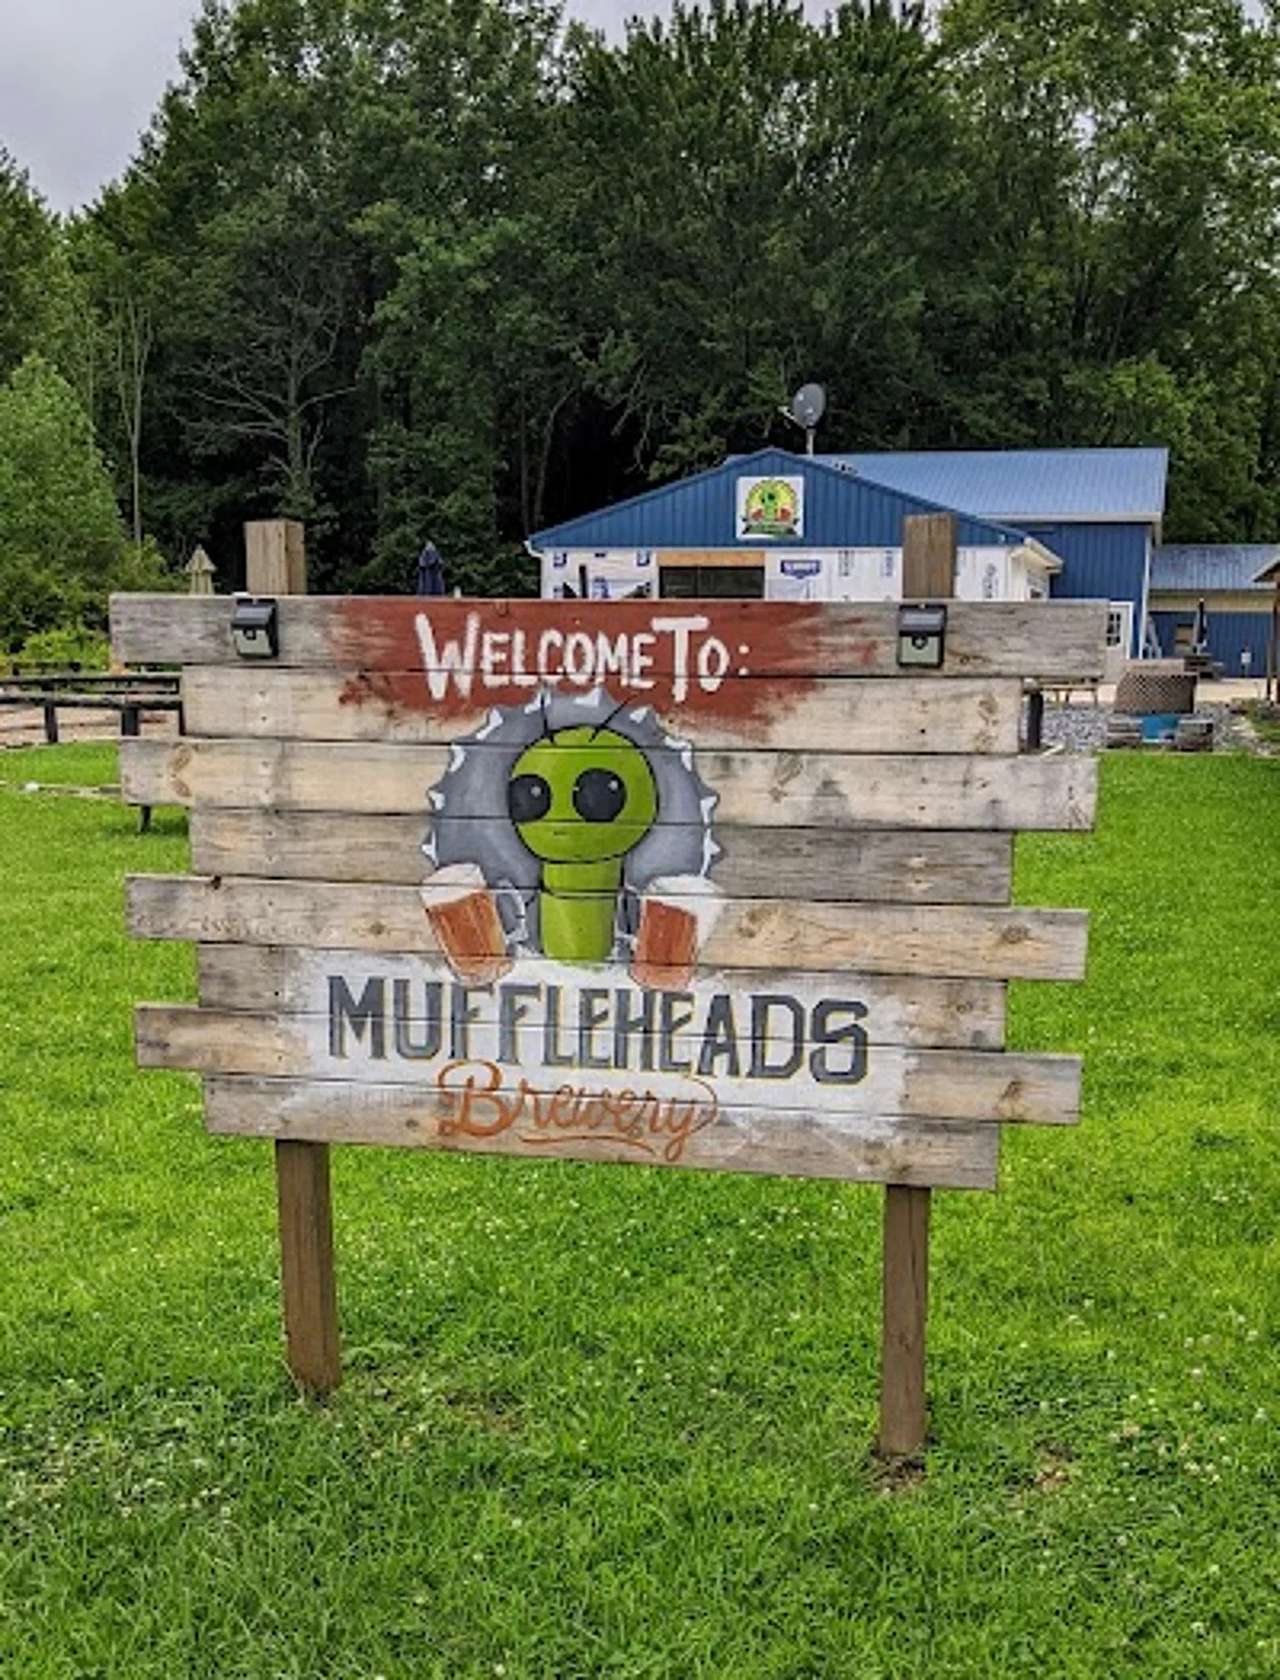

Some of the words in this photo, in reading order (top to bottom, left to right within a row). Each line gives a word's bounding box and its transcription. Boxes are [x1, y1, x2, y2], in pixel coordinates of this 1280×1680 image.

[415, 611, 656, 700] WELCOME
[327, 975, 868, 1085] MUFFLEHEADS
[437, 1058, 717, 1162] Brewery
